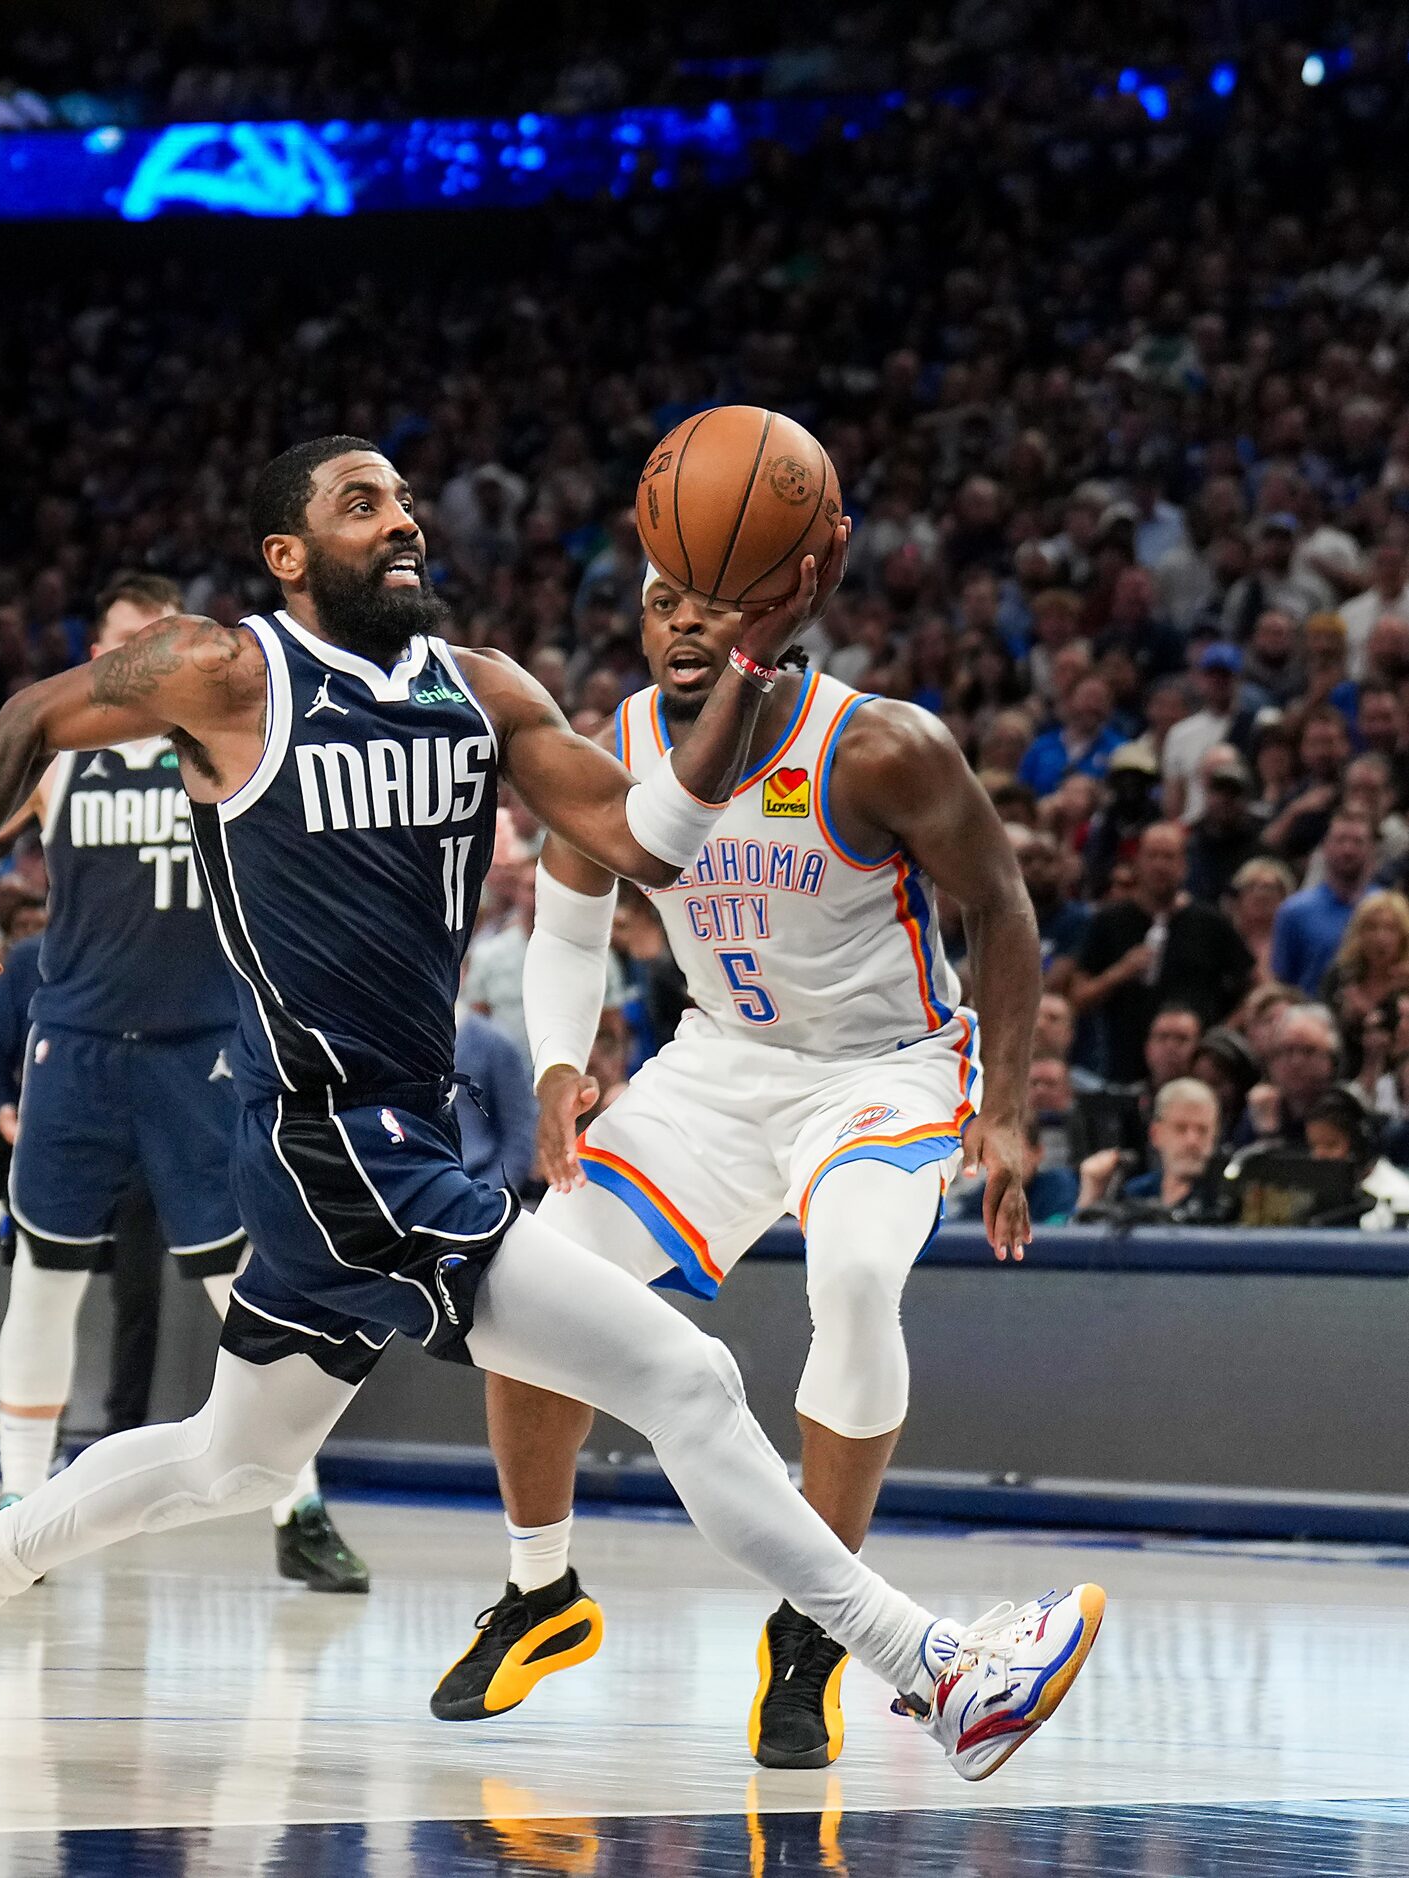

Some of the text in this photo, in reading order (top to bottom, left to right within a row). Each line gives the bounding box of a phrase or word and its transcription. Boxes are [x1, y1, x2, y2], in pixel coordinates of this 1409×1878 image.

[138, 844, 203, 911] 77
[440, 834, 475, 932] 11
[684, 893, 771, 941] CITY
[713, 948, 781, 1026] 5
